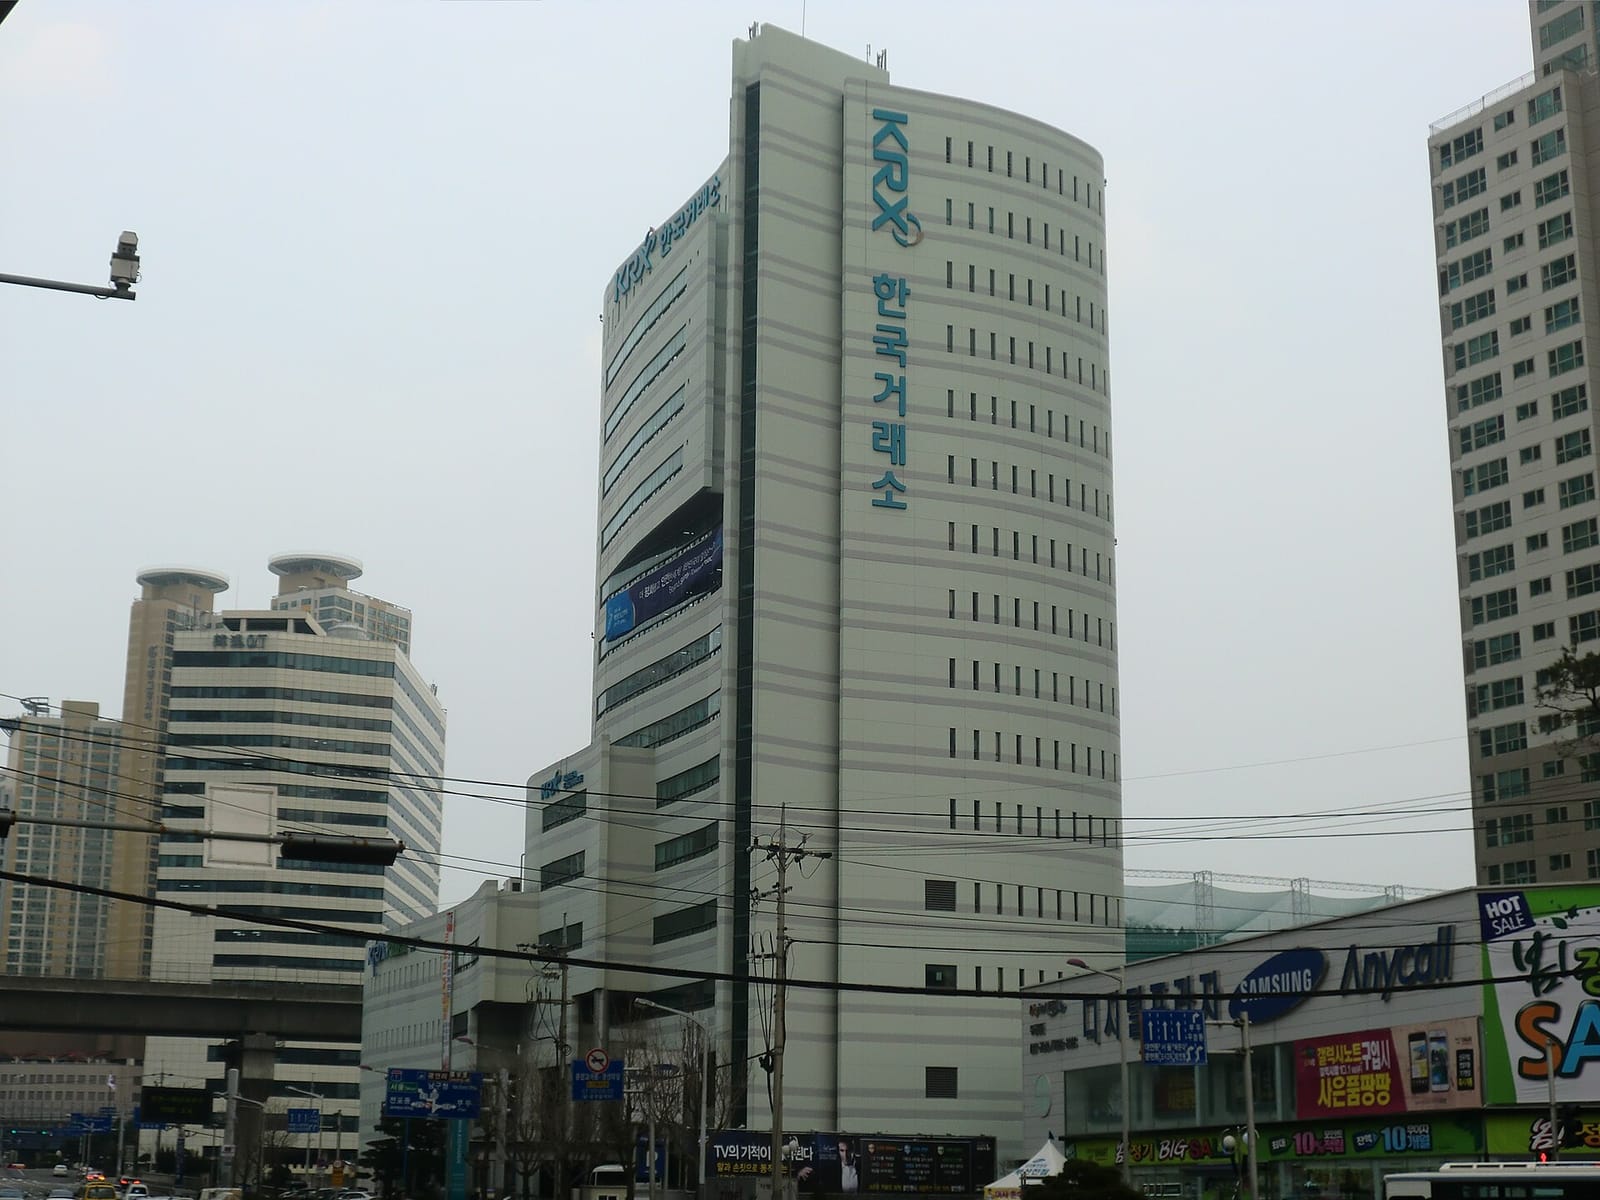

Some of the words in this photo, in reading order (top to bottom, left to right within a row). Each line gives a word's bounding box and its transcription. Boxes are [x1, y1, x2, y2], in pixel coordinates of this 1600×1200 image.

[872, 109, 916, 240] KRX
[614, 230, 657, 303] KRX
[660, 176, 721, 257] 한국거래소
[872, 273, 912, 511] 한국거래소
[1485, 895, 1521, 919] HOT
[1491, 911, 1526, 936] SALE
[1239, 968, 1313, 1002] SAMSUNG
[1341, 925, 1456, 1002] Anycall
[1316, 1042, 1361, 1066] 갤럭시노트
[1361, 1039, 1391, 1071] 구입시
[713, 1144, 739, 1160] TV의
[741, 1144, 771, 1160] 기적이
[1128, 1143, 1154, 1162] 정기
[1159, 1139, 1189, 1160] BIG
